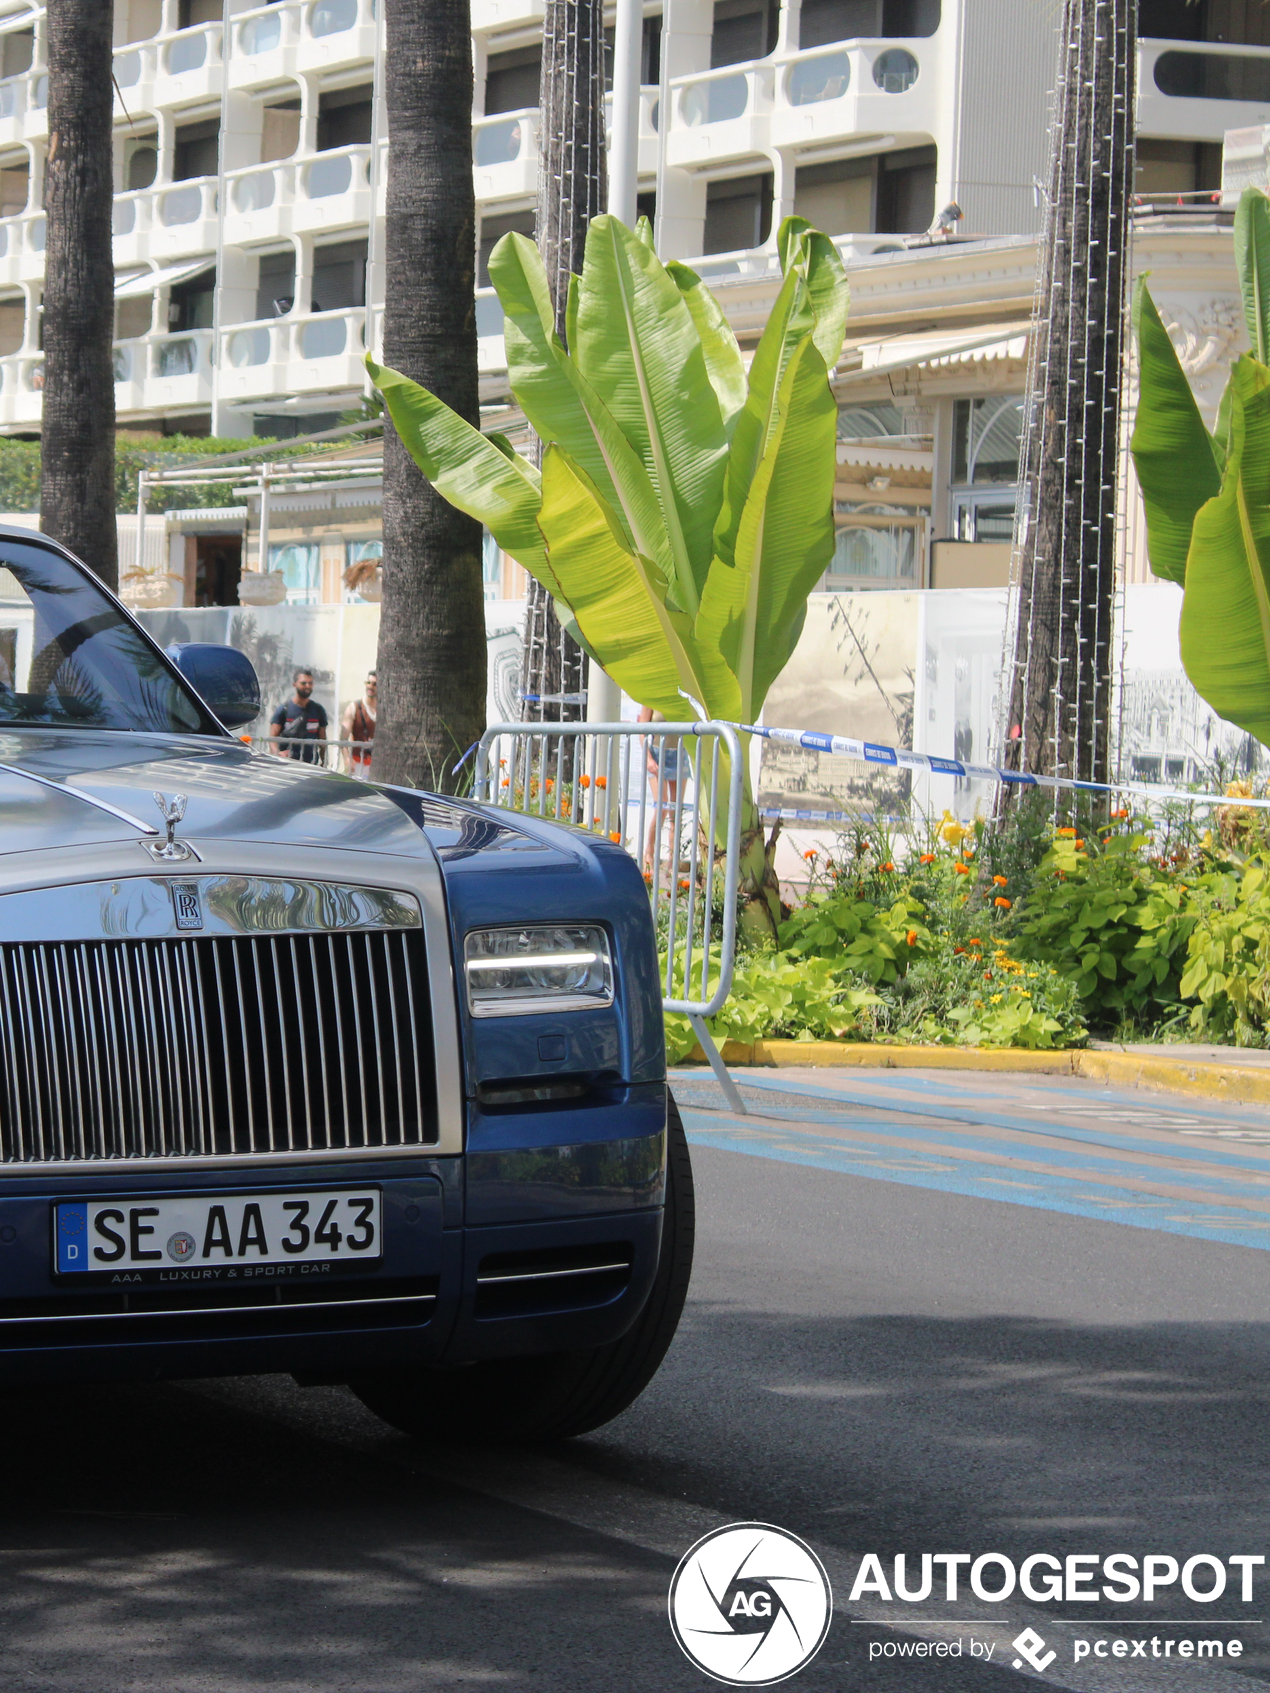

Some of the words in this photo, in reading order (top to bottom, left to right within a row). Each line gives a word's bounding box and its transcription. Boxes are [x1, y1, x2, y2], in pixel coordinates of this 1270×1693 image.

[179, 894, 198, 917] RR
[66, 1245, 79, 1260] D
[93, 1206, 163, 1262] SE
[202, 1202, 269, 1258] AA
[281, 1197, 375, 1255] 343
[112, 1273, 143, 1284] AAA
[160, 1268, 223, 1282] LUXURY
[228, 1268, 238, 1278] &
[244, 1266, 296, 1278] SPORT
[300, 1263, 332, 1275] CAR
